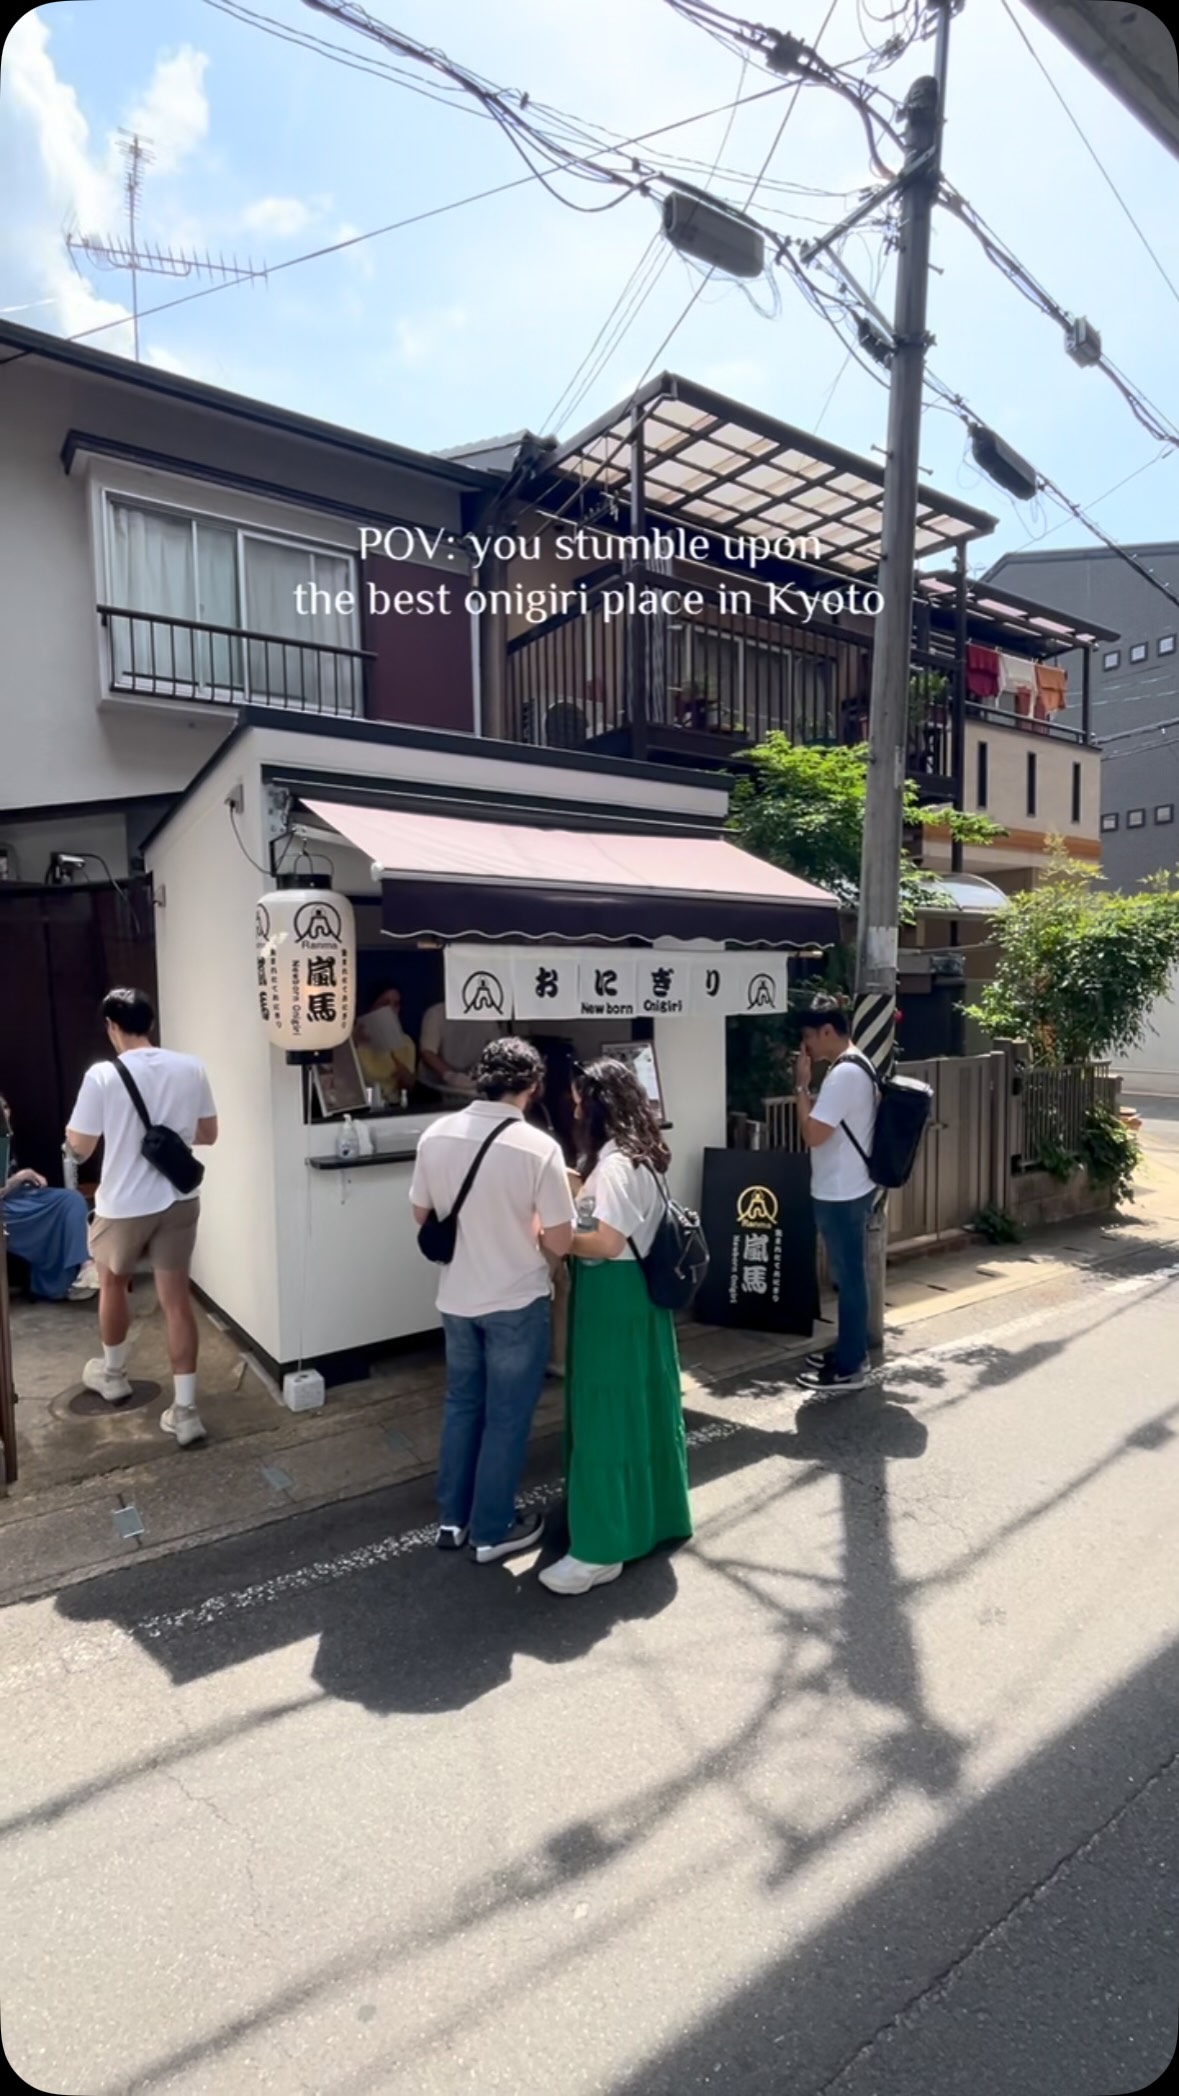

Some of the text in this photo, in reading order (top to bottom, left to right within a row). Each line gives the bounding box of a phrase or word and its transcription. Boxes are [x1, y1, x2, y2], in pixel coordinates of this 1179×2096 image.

[302, 940, 338, 949] Ranma
[290, 960, 302, 1036] Newborn Onigiri
[306, 955, 337, 1023] 嵐馬
[535, 967, 721, 998] おにぎり
[581, 1002, 634, 1015] New born
[643, 999, 683, 1013] Onigiri
[741, 1232, 769, 1294] 嵐馬
